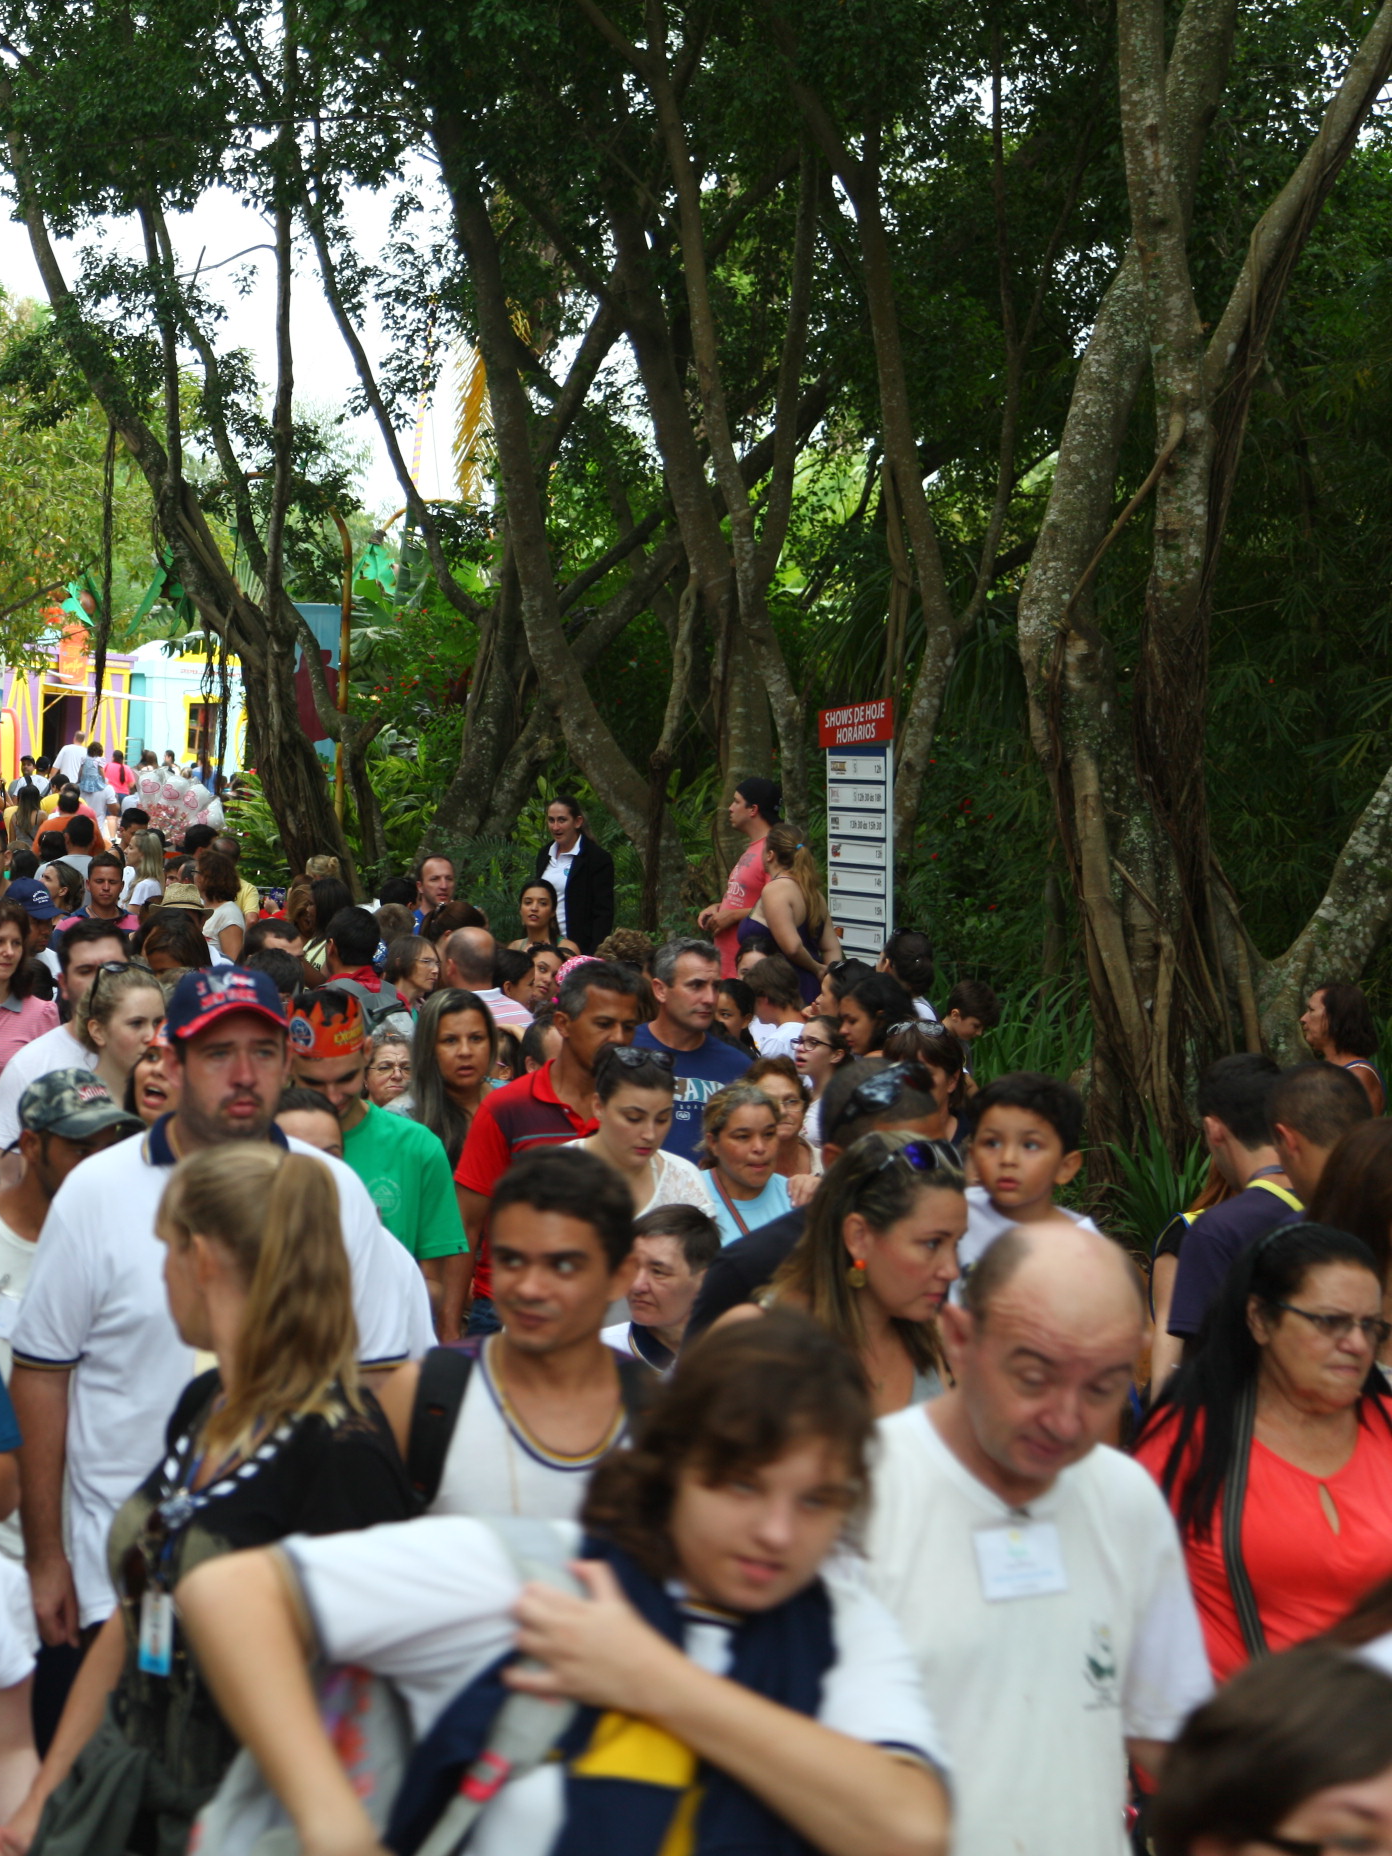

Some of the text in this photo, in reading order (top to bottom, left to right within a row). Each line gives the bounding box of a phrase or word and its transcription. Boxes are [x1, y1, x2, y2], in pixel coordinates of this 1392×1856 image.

[824, 702, 886, 728] SHOWS DE HOJE
[836, 722, 876, 744] HORÁRIOS
